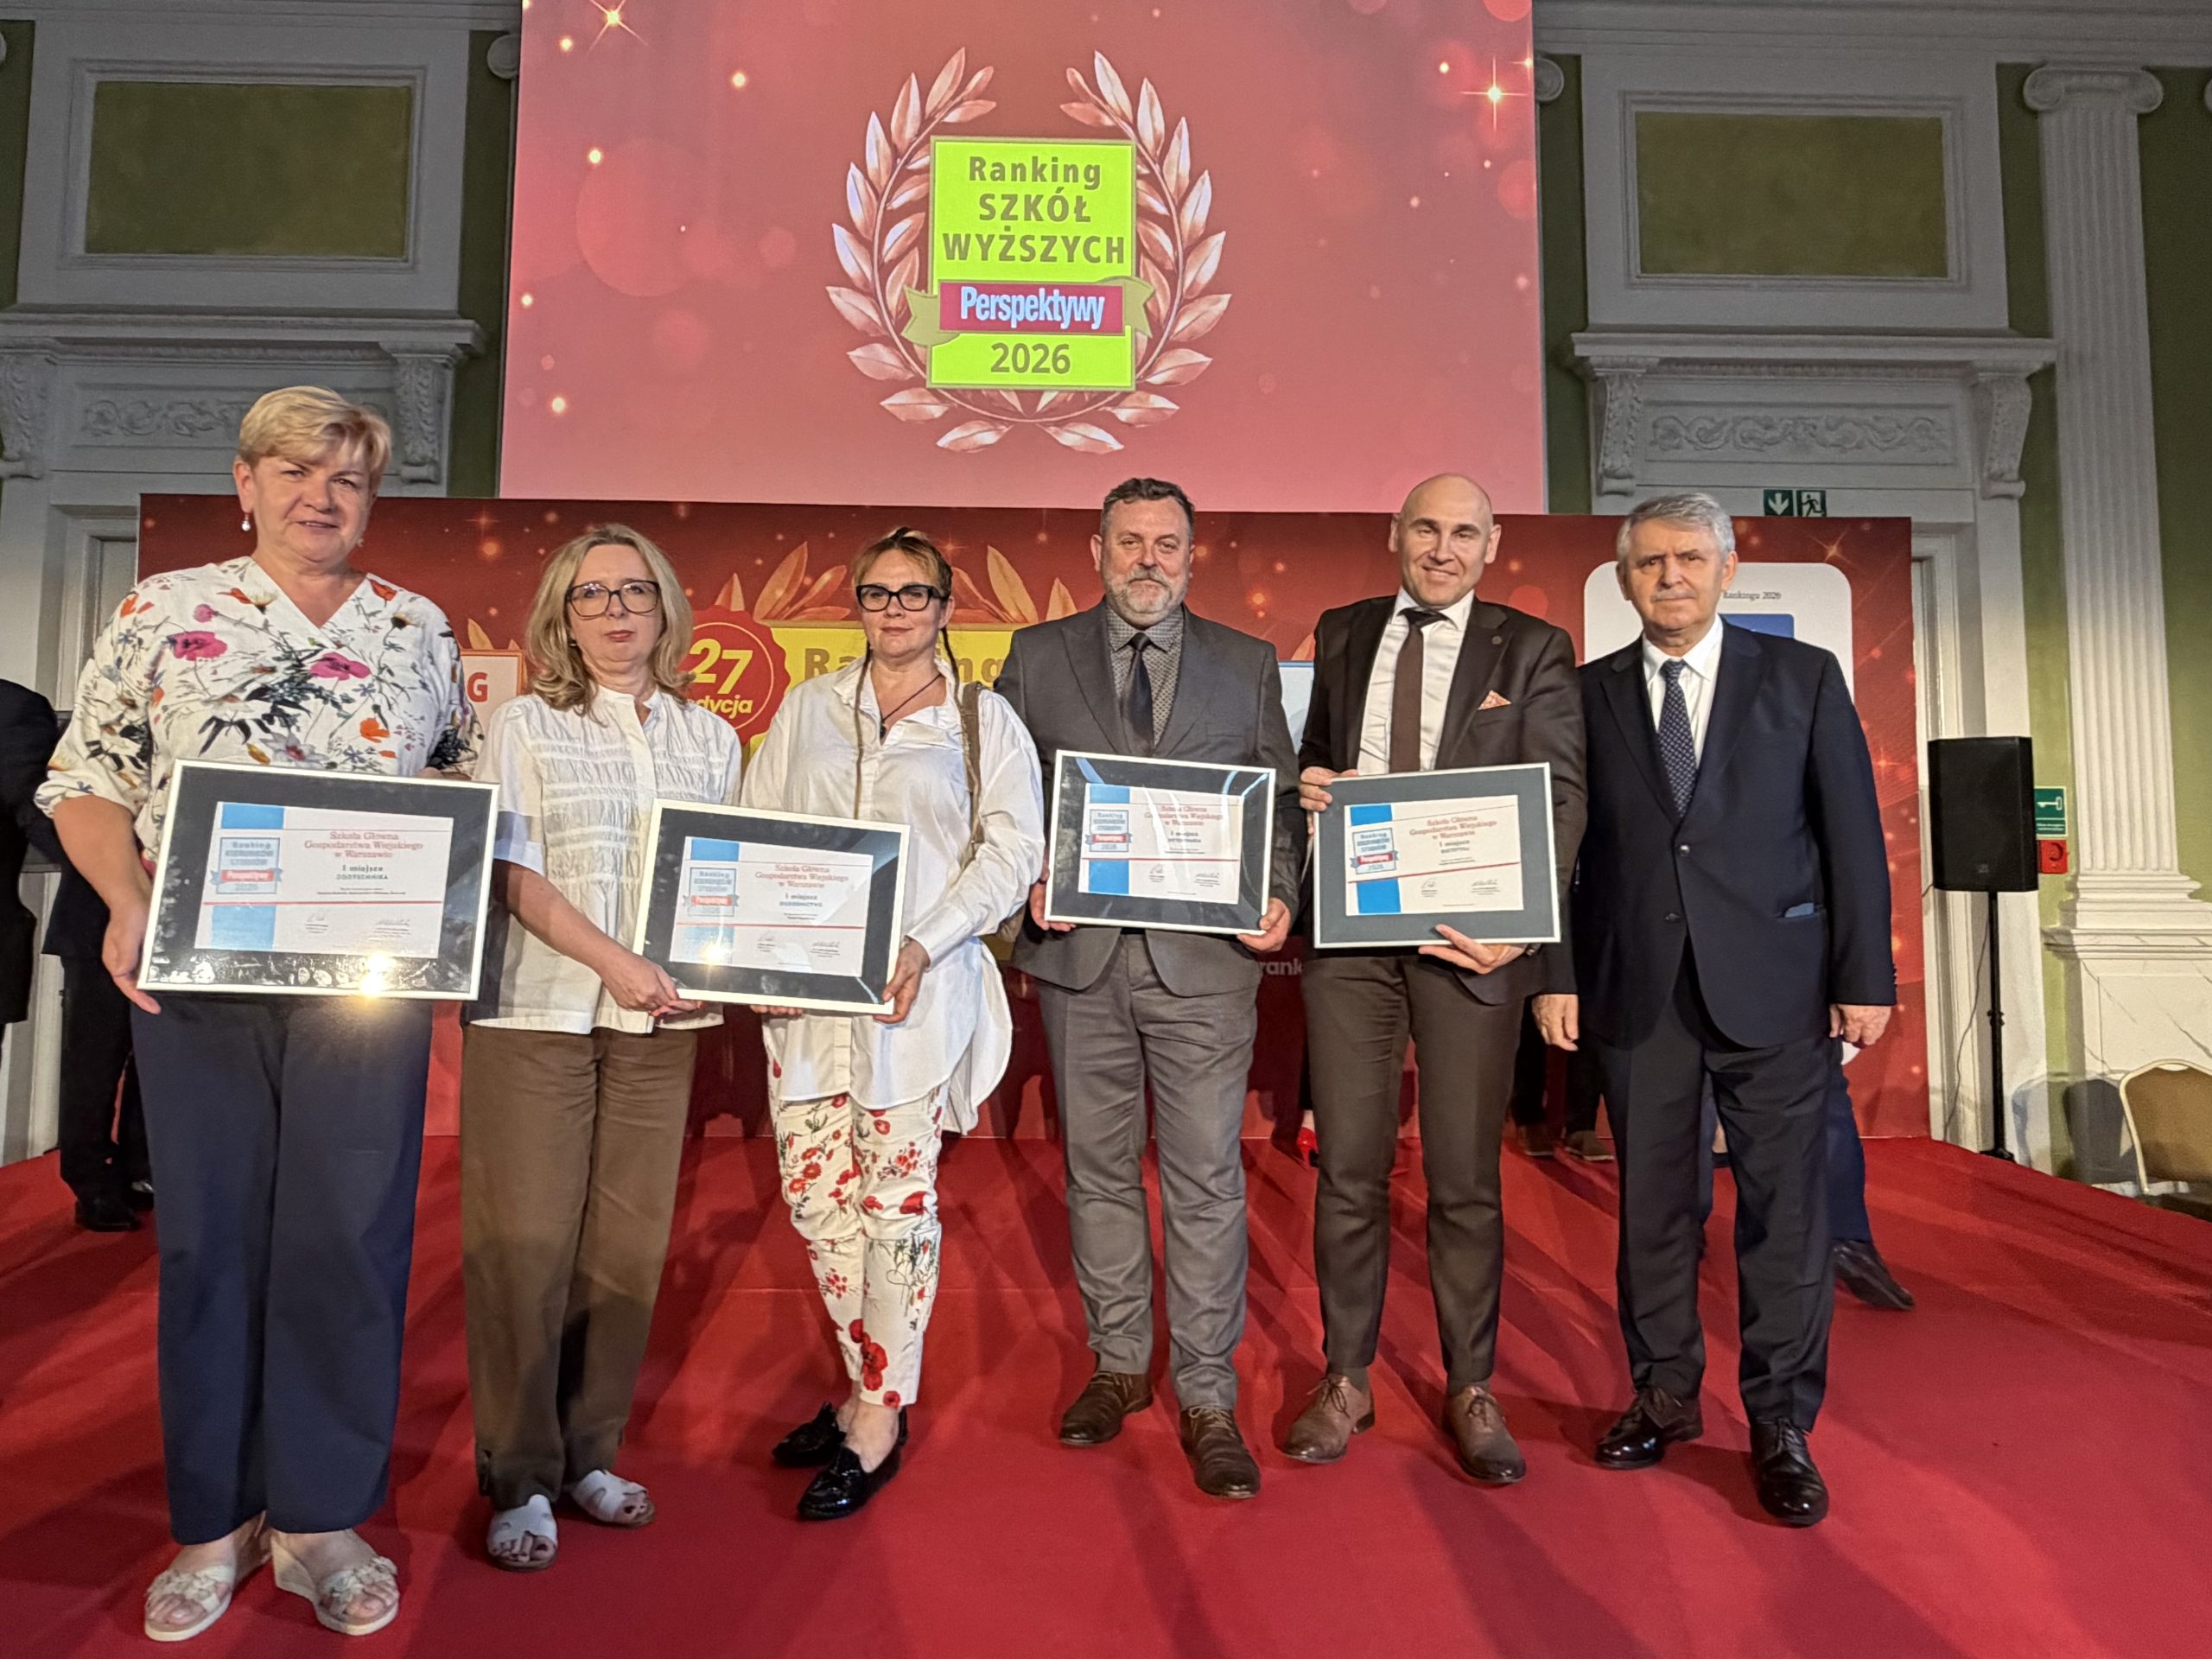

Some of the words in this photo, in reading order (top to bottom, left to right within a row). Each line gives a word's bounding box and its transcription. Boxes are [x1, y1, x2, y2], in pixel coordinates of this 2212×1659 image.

[969, 156, 1101, 190] Ranking
[979, 187, 1090, 223] SZKÓŁ
[943, 225, 1124, 264] WYŻSZYCH
[961, 286, 1105, 330] Perspektywy
[990, 342, 1071, 375] 2026
[689, 638, 753, 695] 27
[687, 694, 753, 719] dycja
